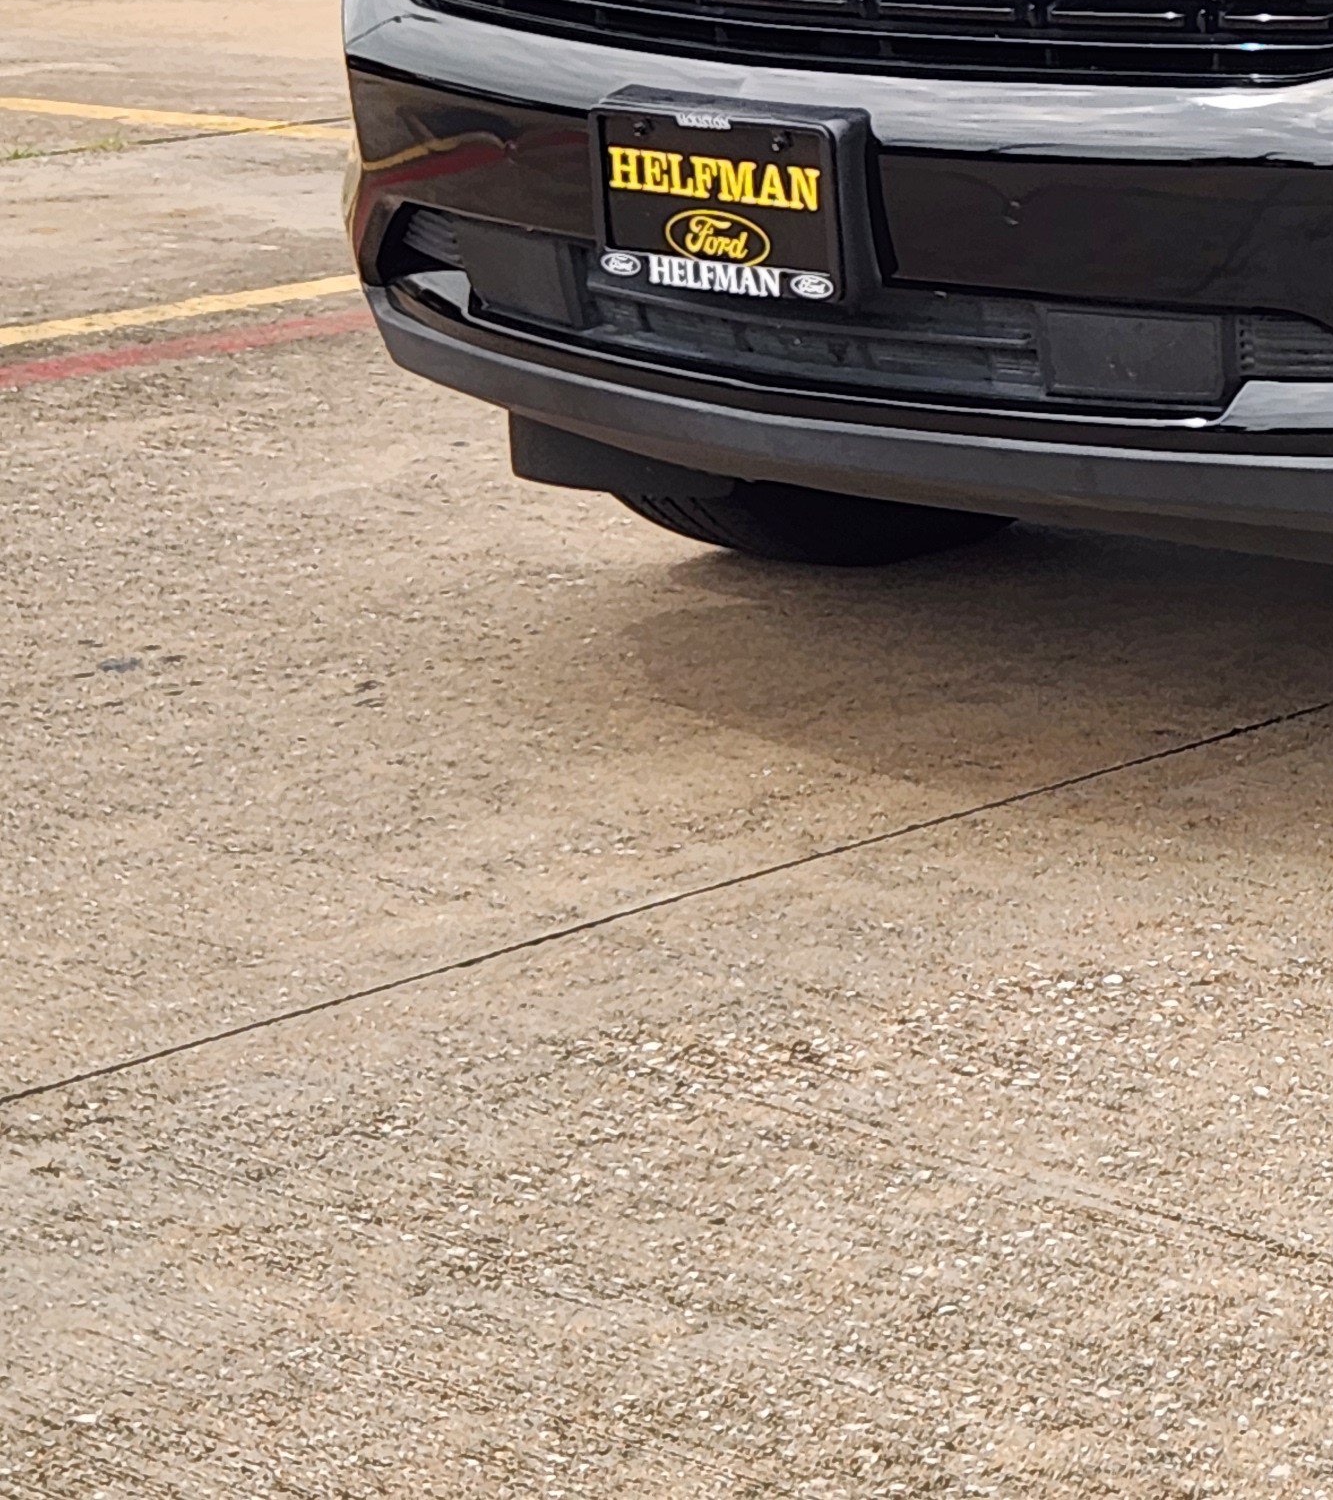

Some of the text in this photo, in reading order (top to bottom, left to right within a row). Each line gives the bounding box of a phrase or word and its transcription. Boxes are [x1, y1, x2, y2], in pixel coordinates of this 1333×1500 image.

[607, 146, 821, 211] HELFMAN
[684, 215, 749, 259] Ford
[648, 255, 783, 297] HELFMAN
